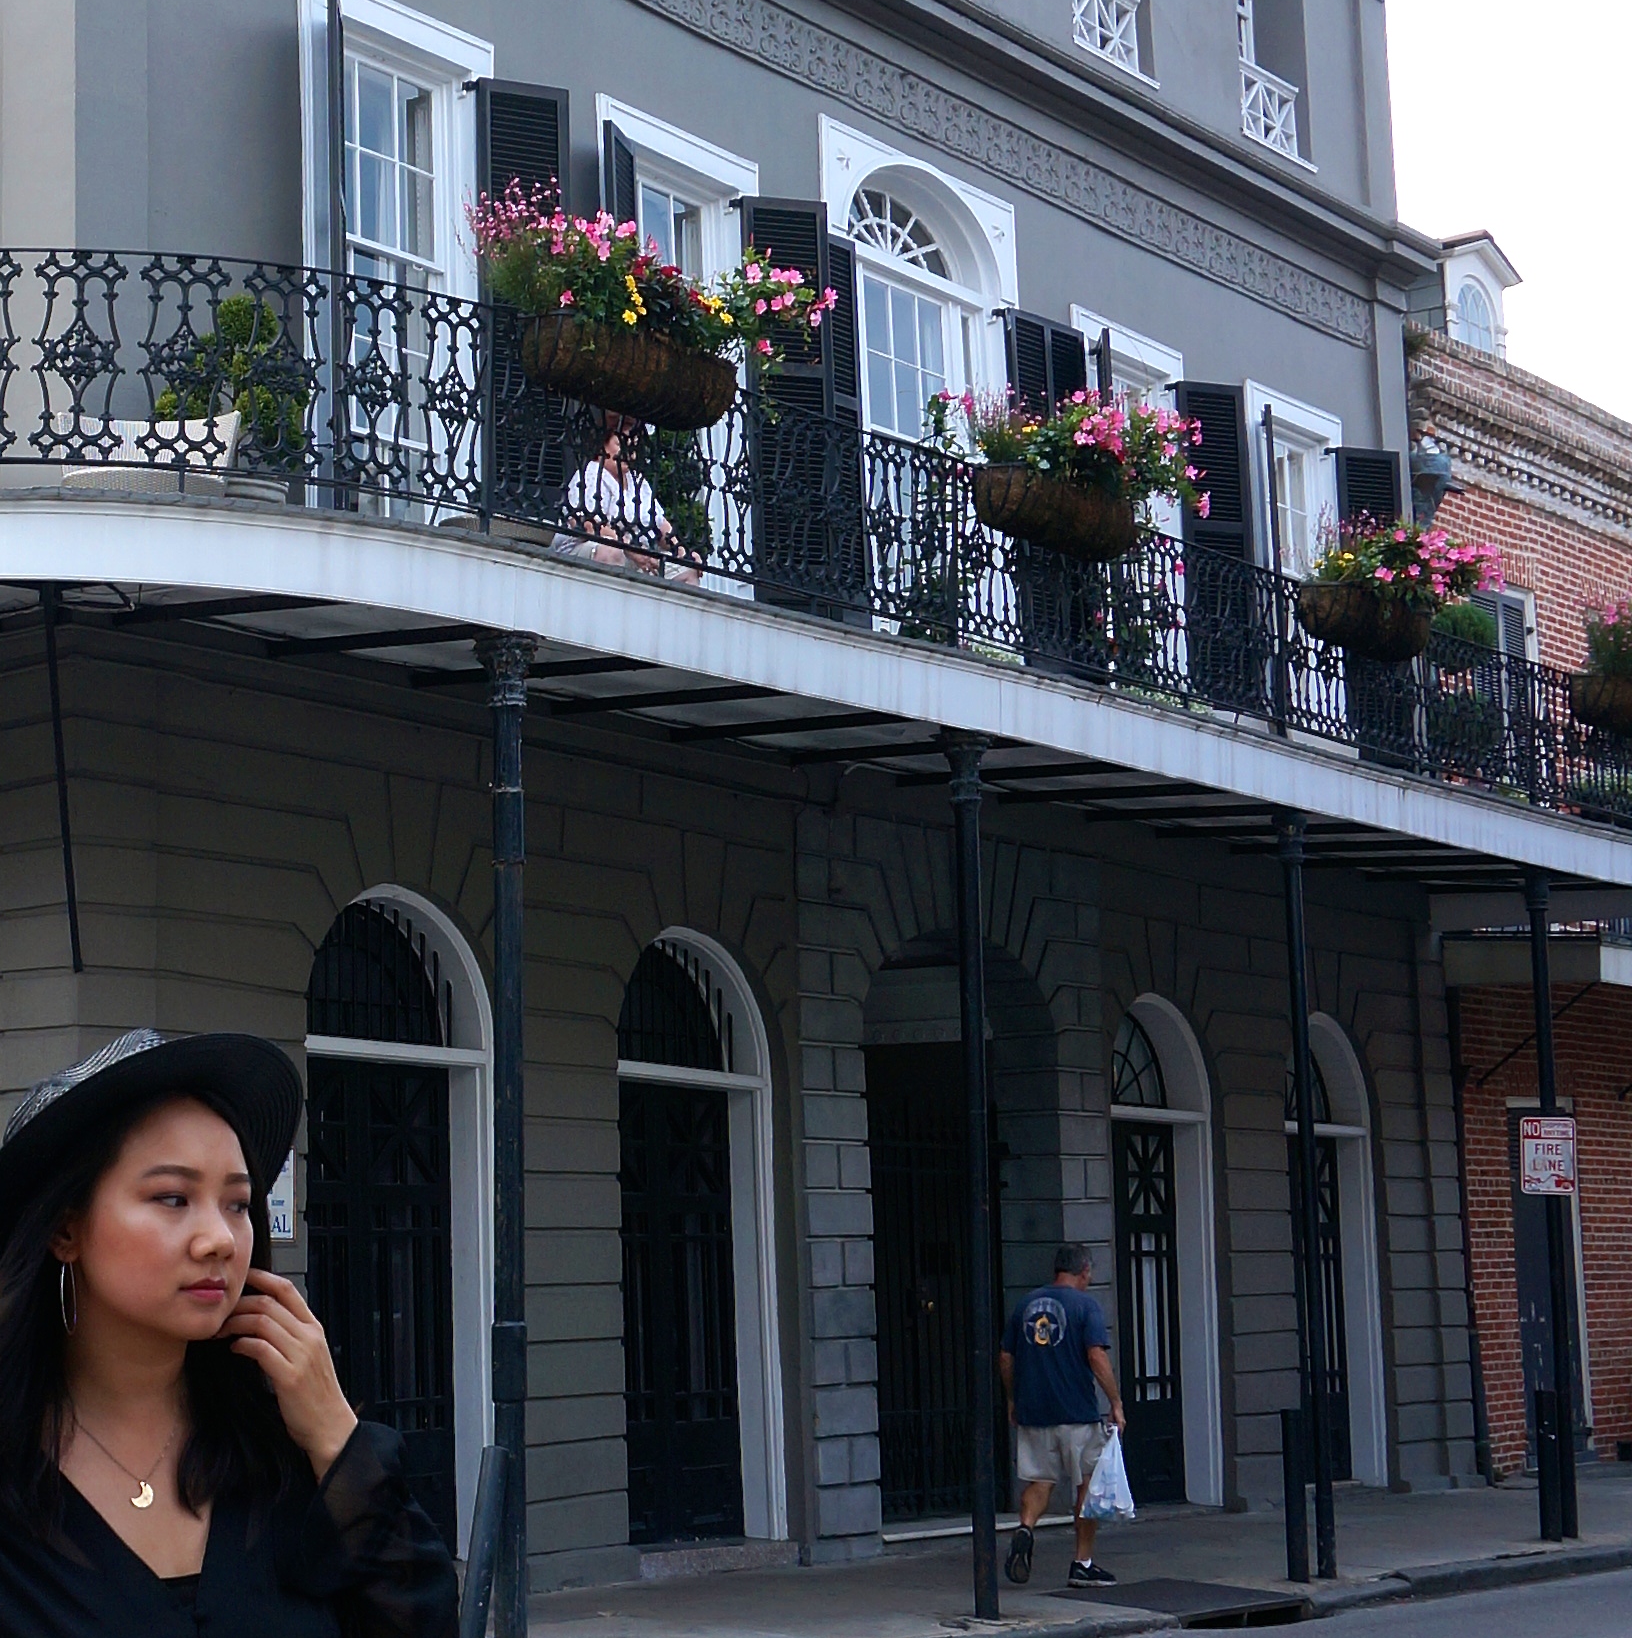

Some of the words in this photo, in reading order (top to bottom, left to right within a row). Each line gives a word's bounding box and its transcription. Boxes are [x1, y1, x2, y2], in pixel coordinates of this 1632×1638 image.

[1523, 1122, 1540, 1136] NO
[1534, 1143, 1563, 1156] FIRE
[1532, 1159, 1565, 1172] LANE
